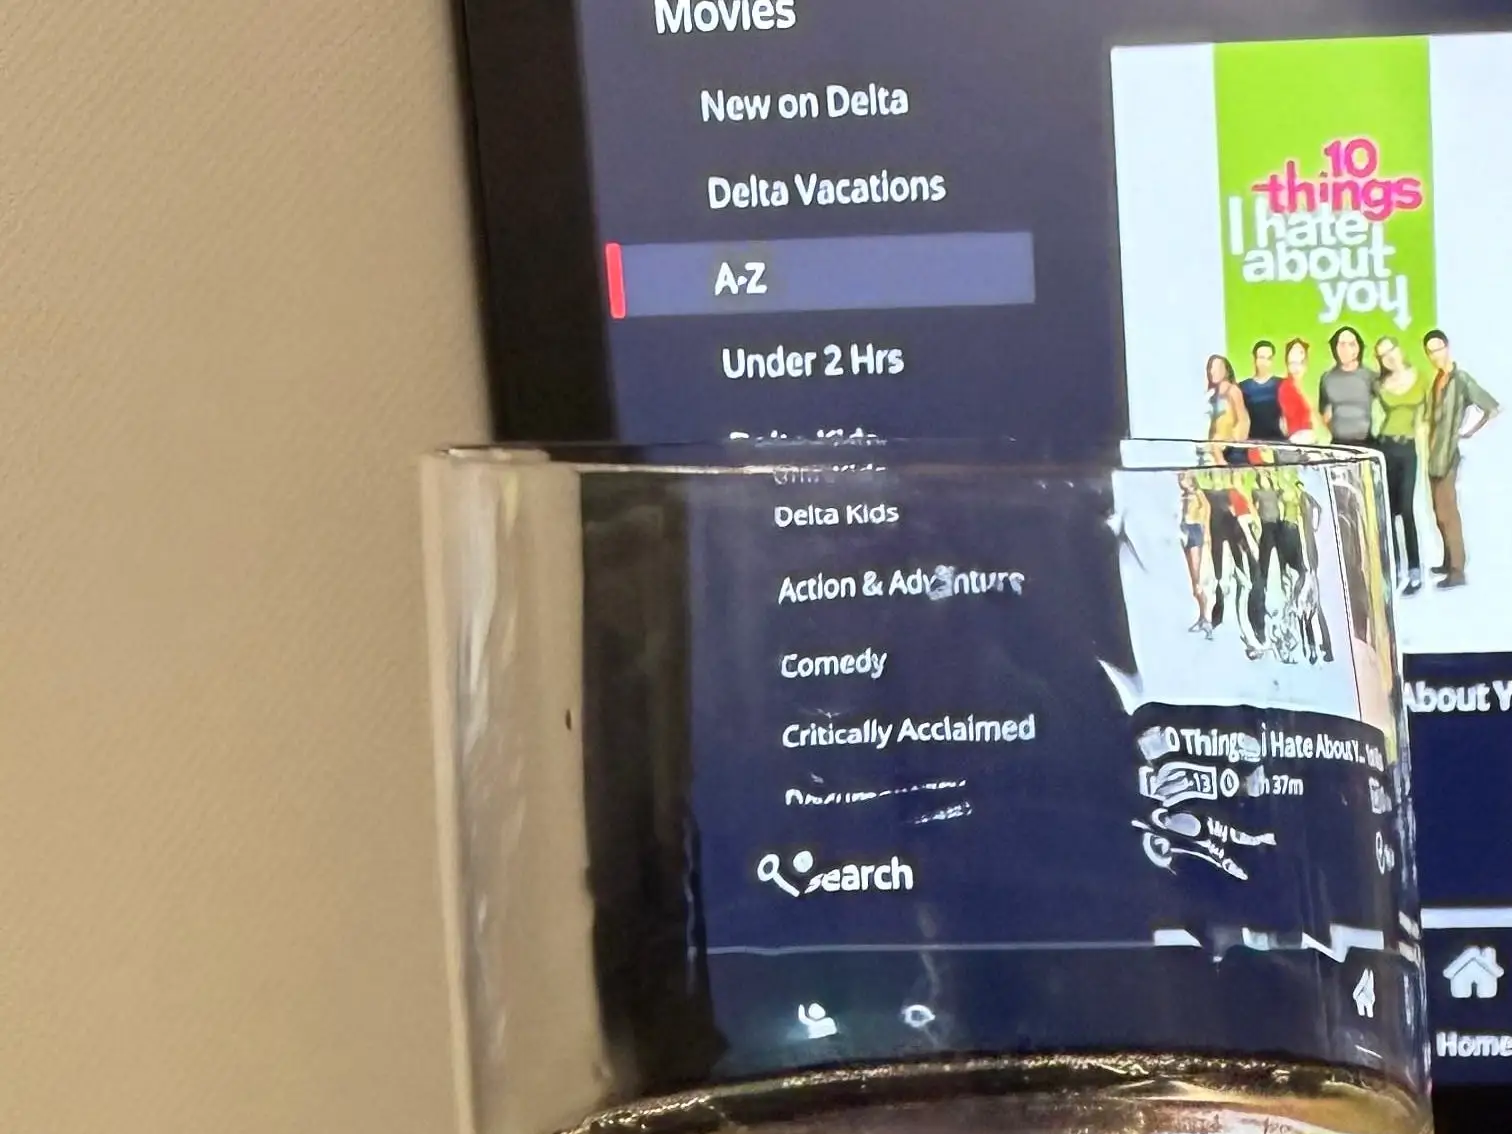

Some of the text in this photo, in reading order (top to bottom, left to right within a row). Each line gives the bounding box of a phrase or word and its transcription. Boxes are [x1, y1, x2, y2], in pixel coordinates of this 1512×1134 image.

[655, 0, 796, 33] Movies
[701, 84, 909, 121] New on Delta
[1323, 138, 1377, 178] 10
[708, 170, 947, 209] Delta Vacations
[1251, 160, 1423, 221] things
[1228, 196, 1369, 255] I hate
[1242, 221, 1396, 283] about
[715, 262, 767, 295] A-Z
[1317, 275, 1412, 331] you
[722, 343, 905, 379] Under 2 Hrs
[774, 504, 900, 527] Delta Kids
[778, 573, 856, 604] Action
[862, 571, 883, 597] &
[781, 648, 888, 679] Comedy
[1403, 681, 1490, 713] About
[782, 714, 1036, 749] Critically Acclaimed
[1181, 729, 1256, 761] Things
[1270, 730, 1313, 759] Hate
[1315, 734, 1349, 762] About
[1272, 775, 1303, 796] 37m
